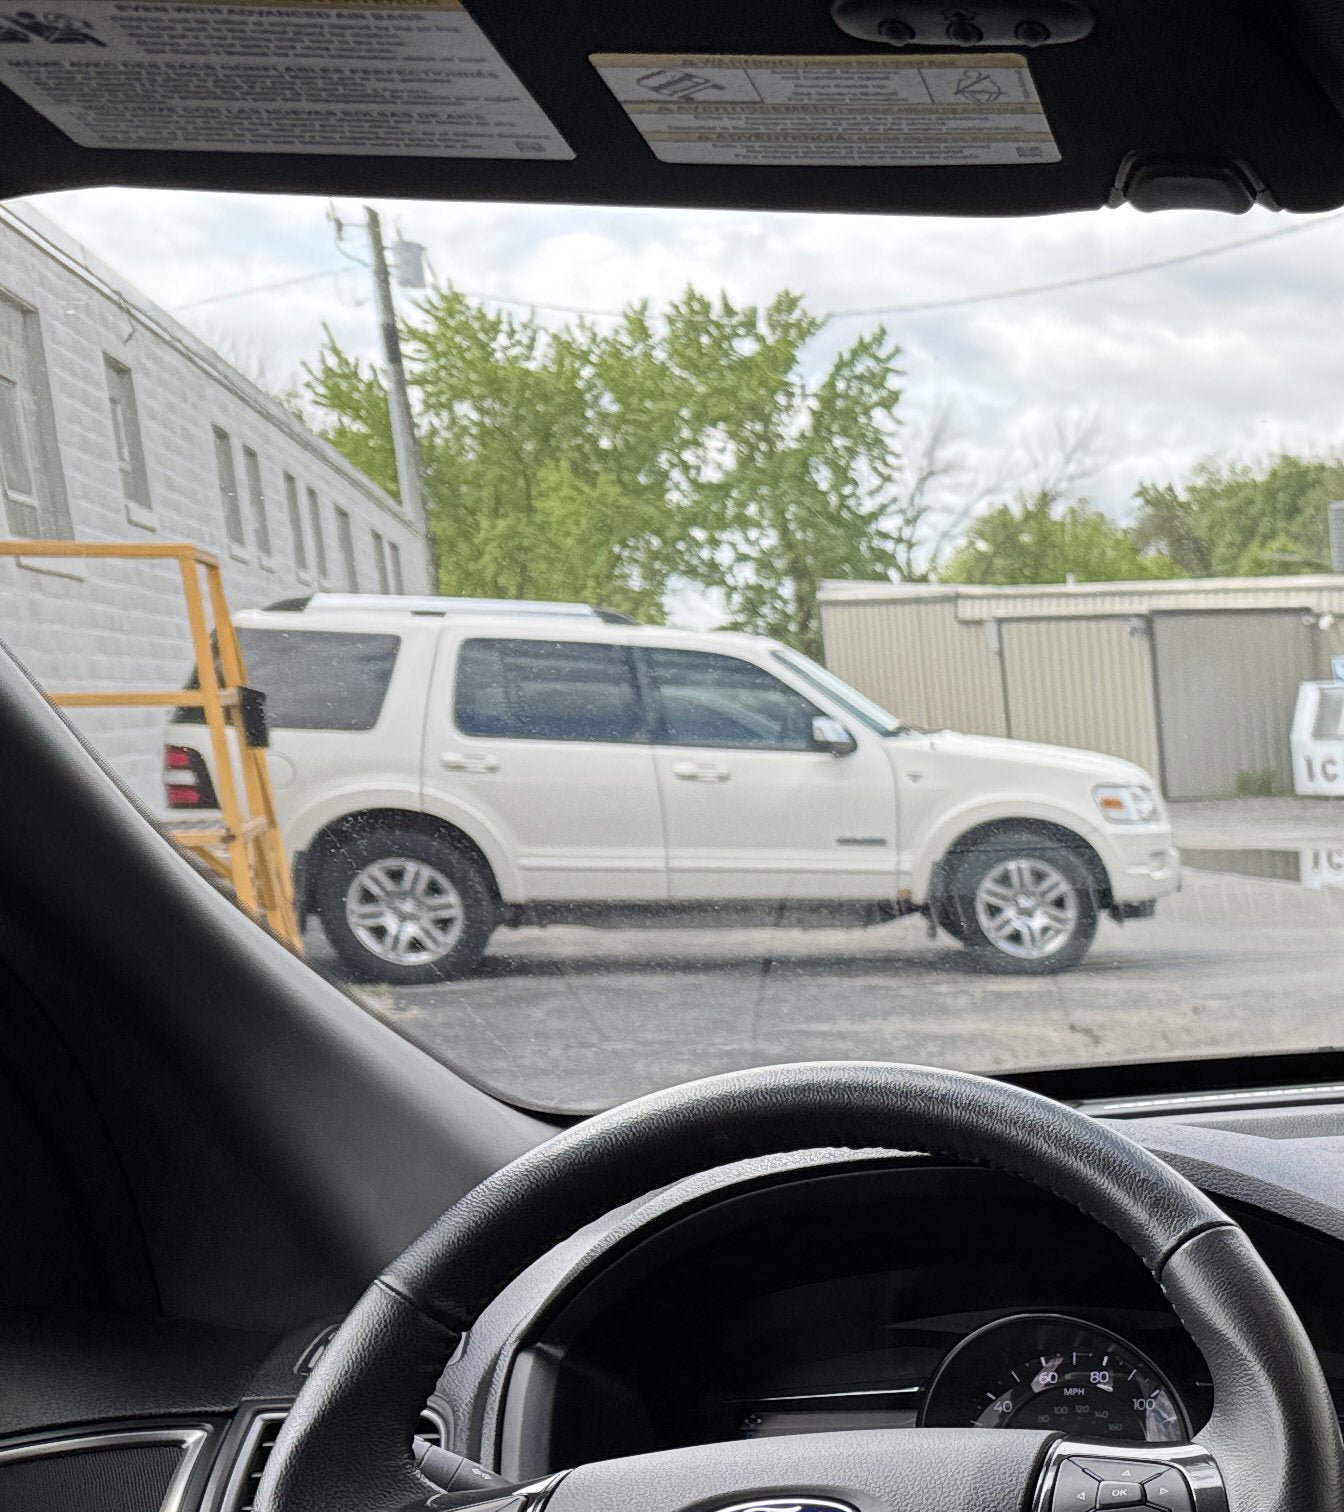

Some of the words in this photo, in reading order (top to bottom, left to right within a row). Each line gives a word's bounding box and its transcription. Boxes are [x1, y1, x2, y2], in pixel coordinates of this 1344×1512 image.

[1038, 1372, 1058, 1384] 60
[1089, 1371, 1109, 1384] 80
[1063, 1388, 1085, 1396] MPH
[994, 1401, 1013, 1413] 40
[1132, 1398, 1156, 1411] 100
[1111, 1488, 1128, 1497] OK
